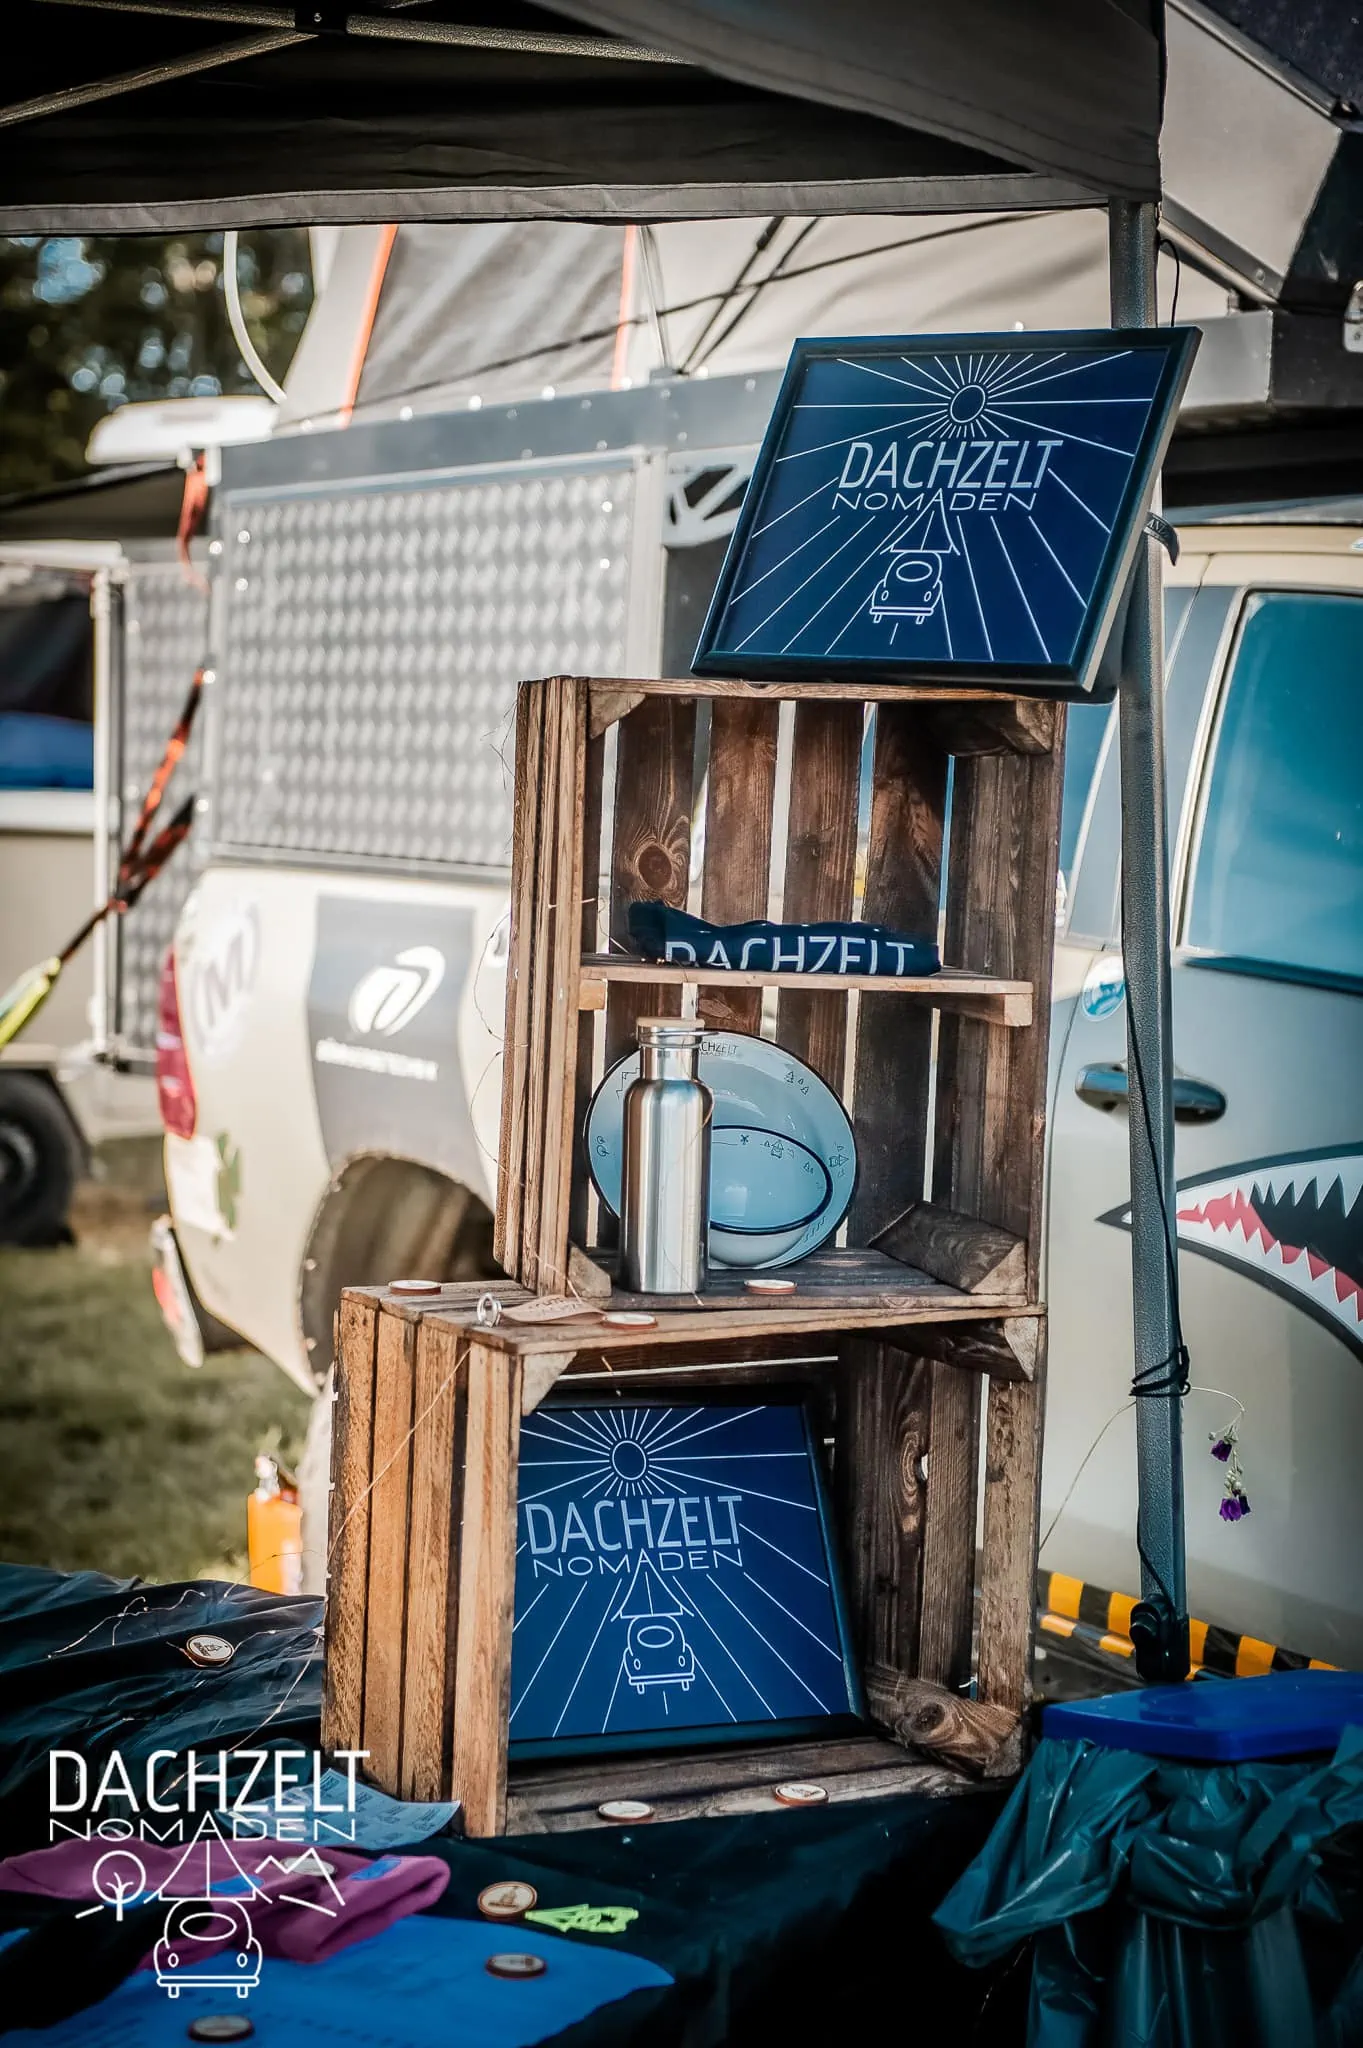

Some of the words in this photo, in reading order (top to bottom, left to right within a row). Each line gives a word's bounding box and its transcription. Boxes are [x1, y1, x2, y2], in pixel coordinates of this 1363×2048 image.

[838, 439, 1064, 489] DACHZELT
[831, 490, 1038, 511] NOMADEN
[525, 1495, 742, 1554] DACHZELT
[533, 1549, 743, 1578] NOMADEN
